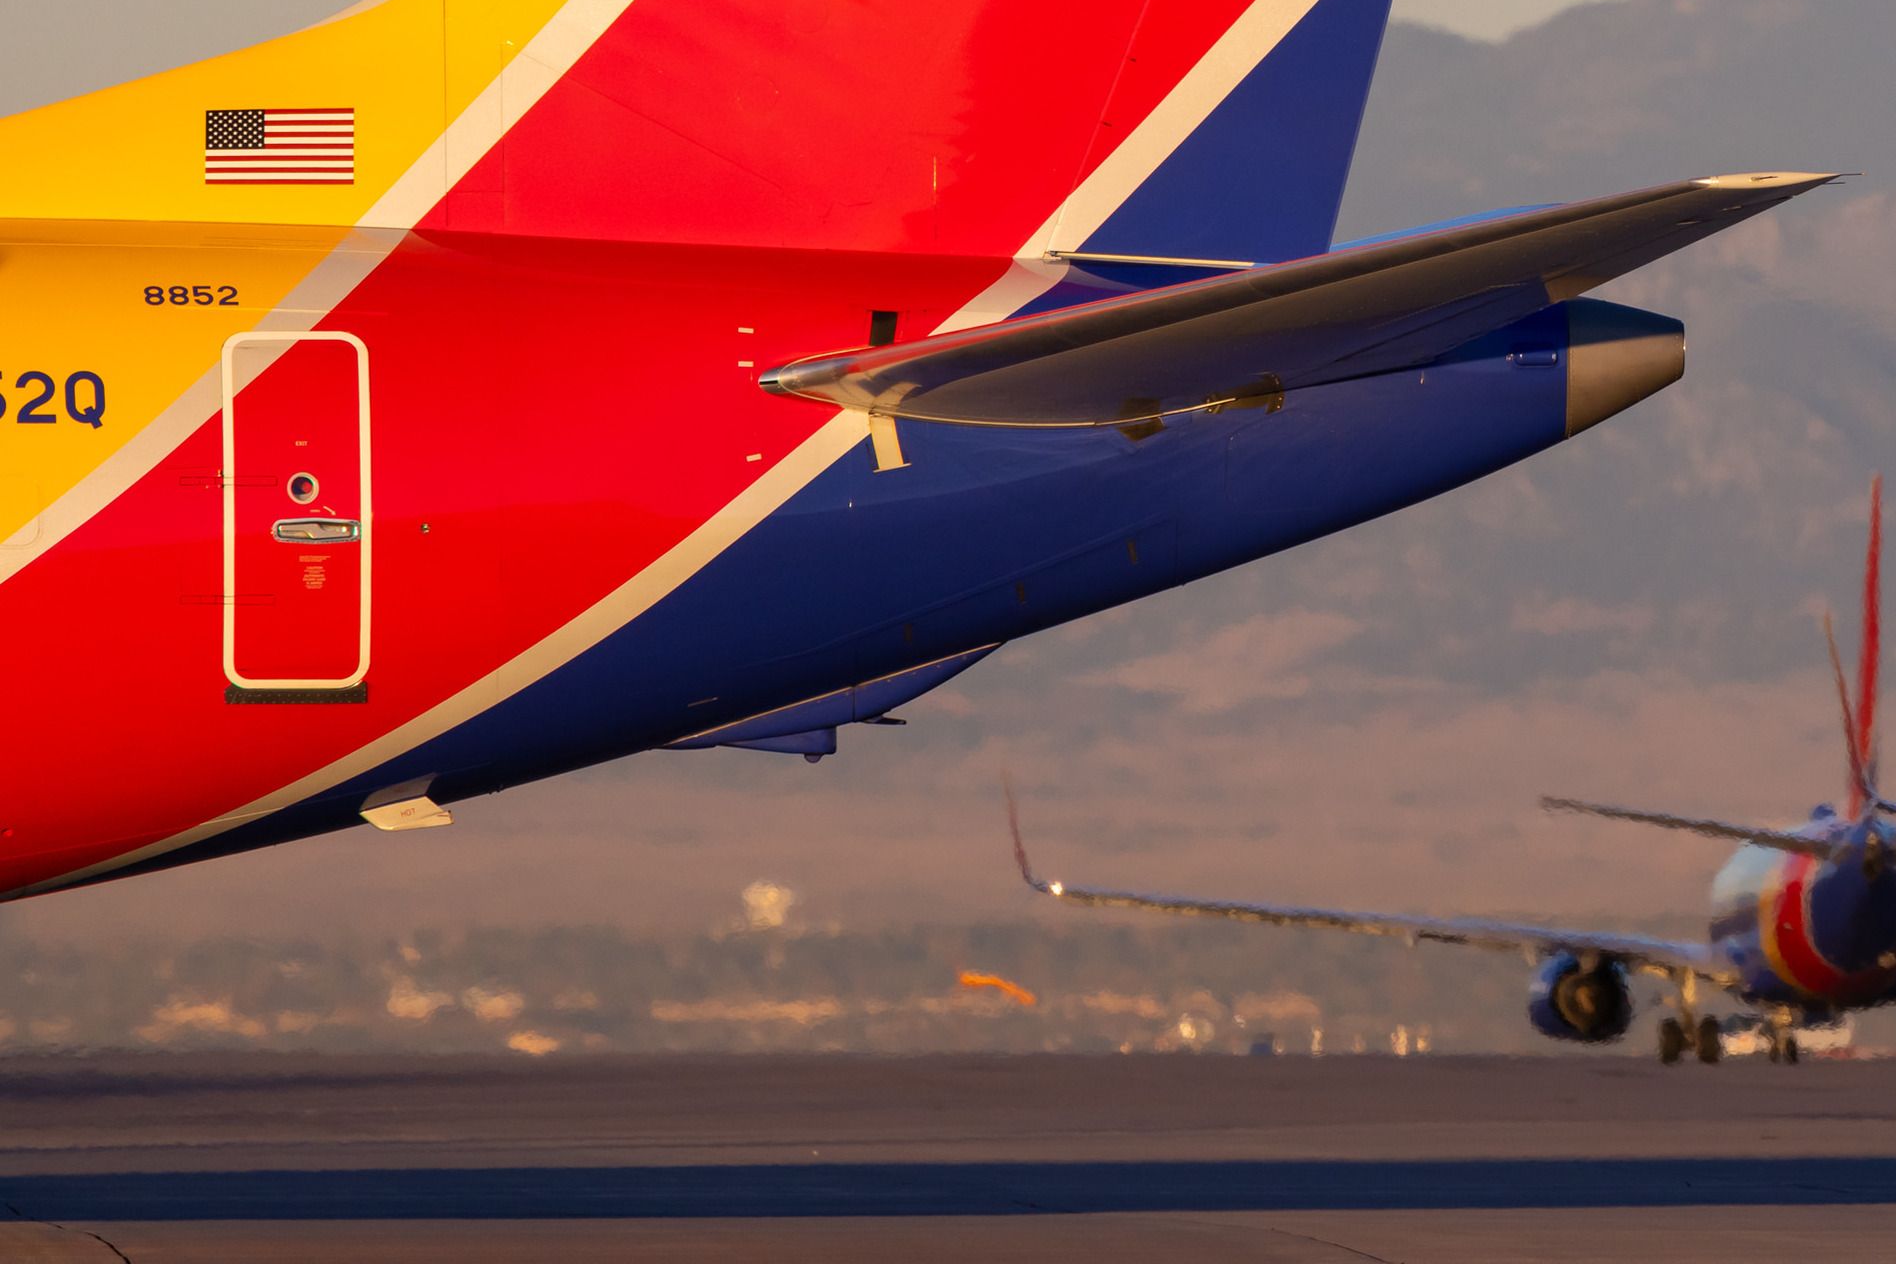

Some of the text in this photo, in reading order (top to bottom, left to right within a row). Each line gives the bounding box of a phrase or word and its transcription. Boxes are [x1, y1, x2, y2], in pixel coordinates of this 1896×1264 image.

[143, 285, 239, 306] 8852
[0, 370, 106, 429] 2Q
[400, 807, 416, 817] HOT
